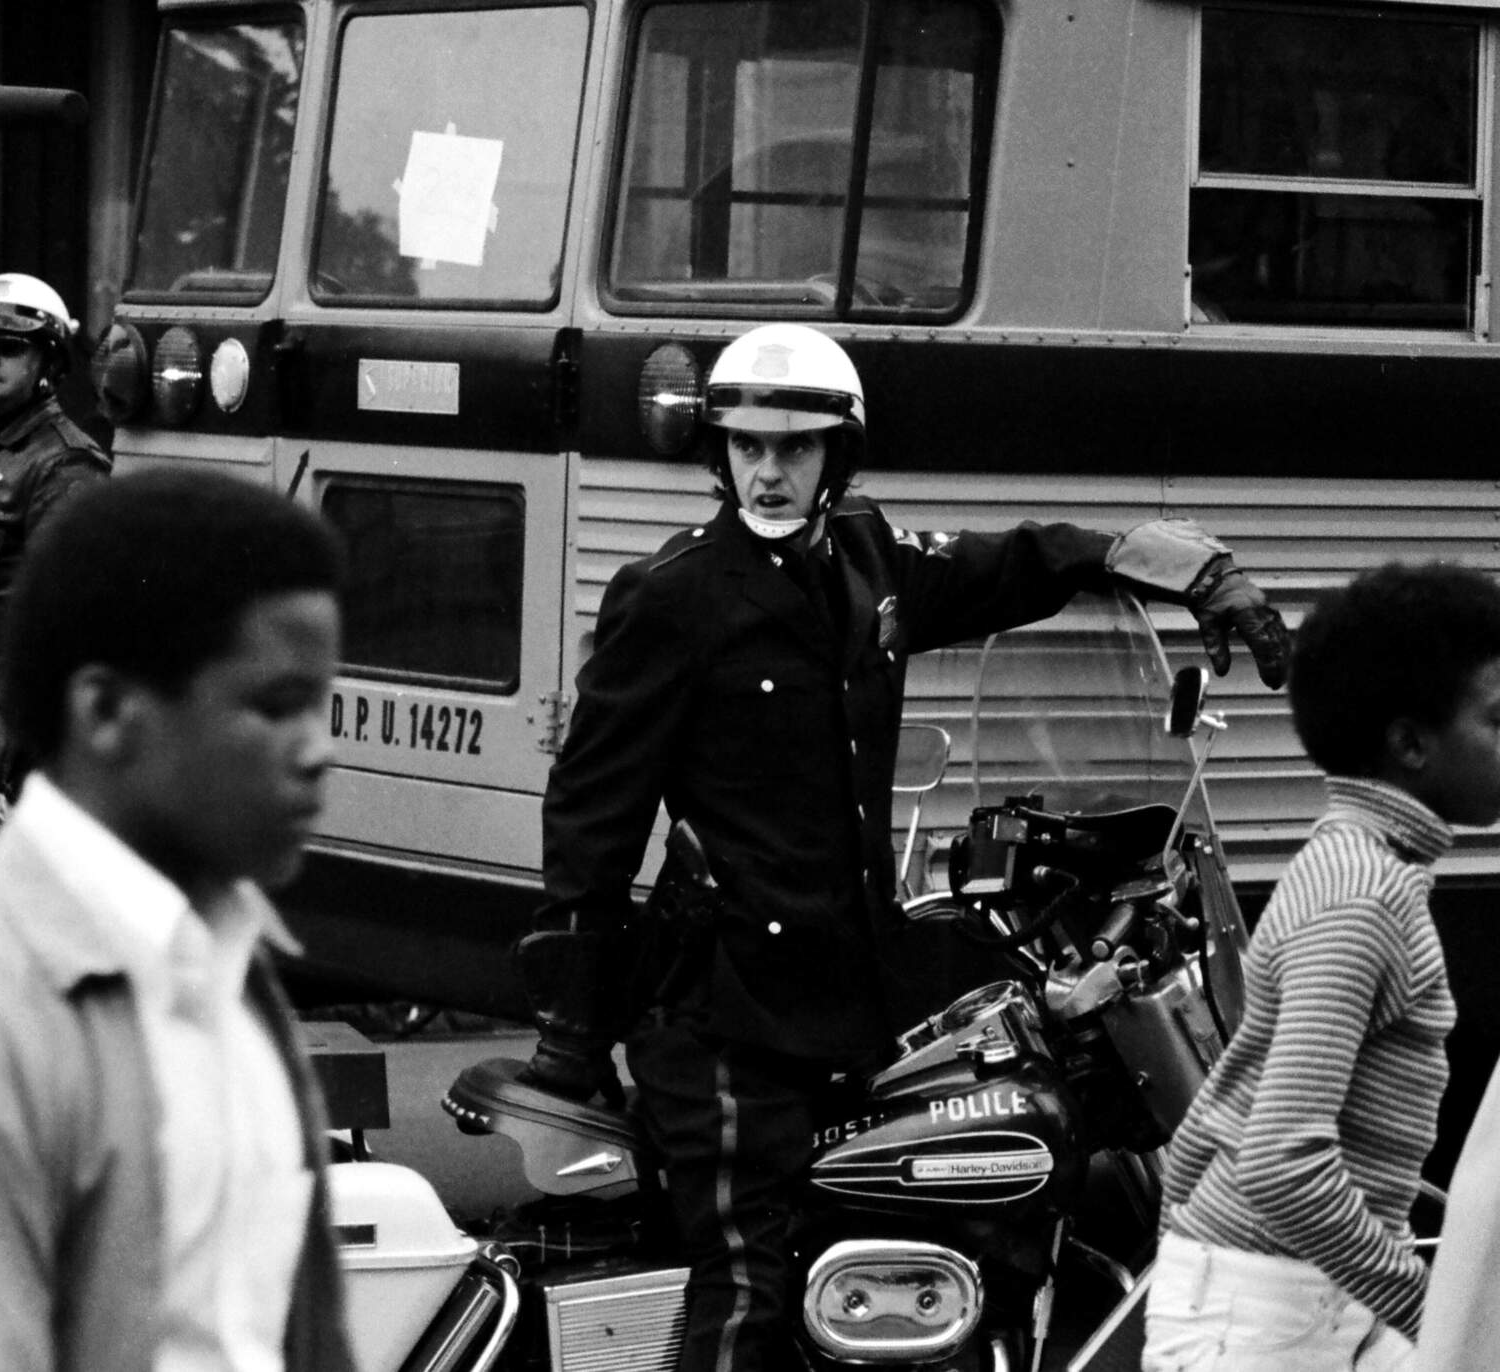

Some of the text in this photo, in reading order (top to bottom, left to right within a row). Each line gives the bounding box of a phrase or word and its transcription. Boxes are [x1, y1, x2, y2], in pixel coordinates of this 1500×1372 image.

[409, 702, 484, 755] 14272
[928, 1090, 1029, 1125] POLICE
[951, 1160, 1042, 1176] Harley-Davidson
